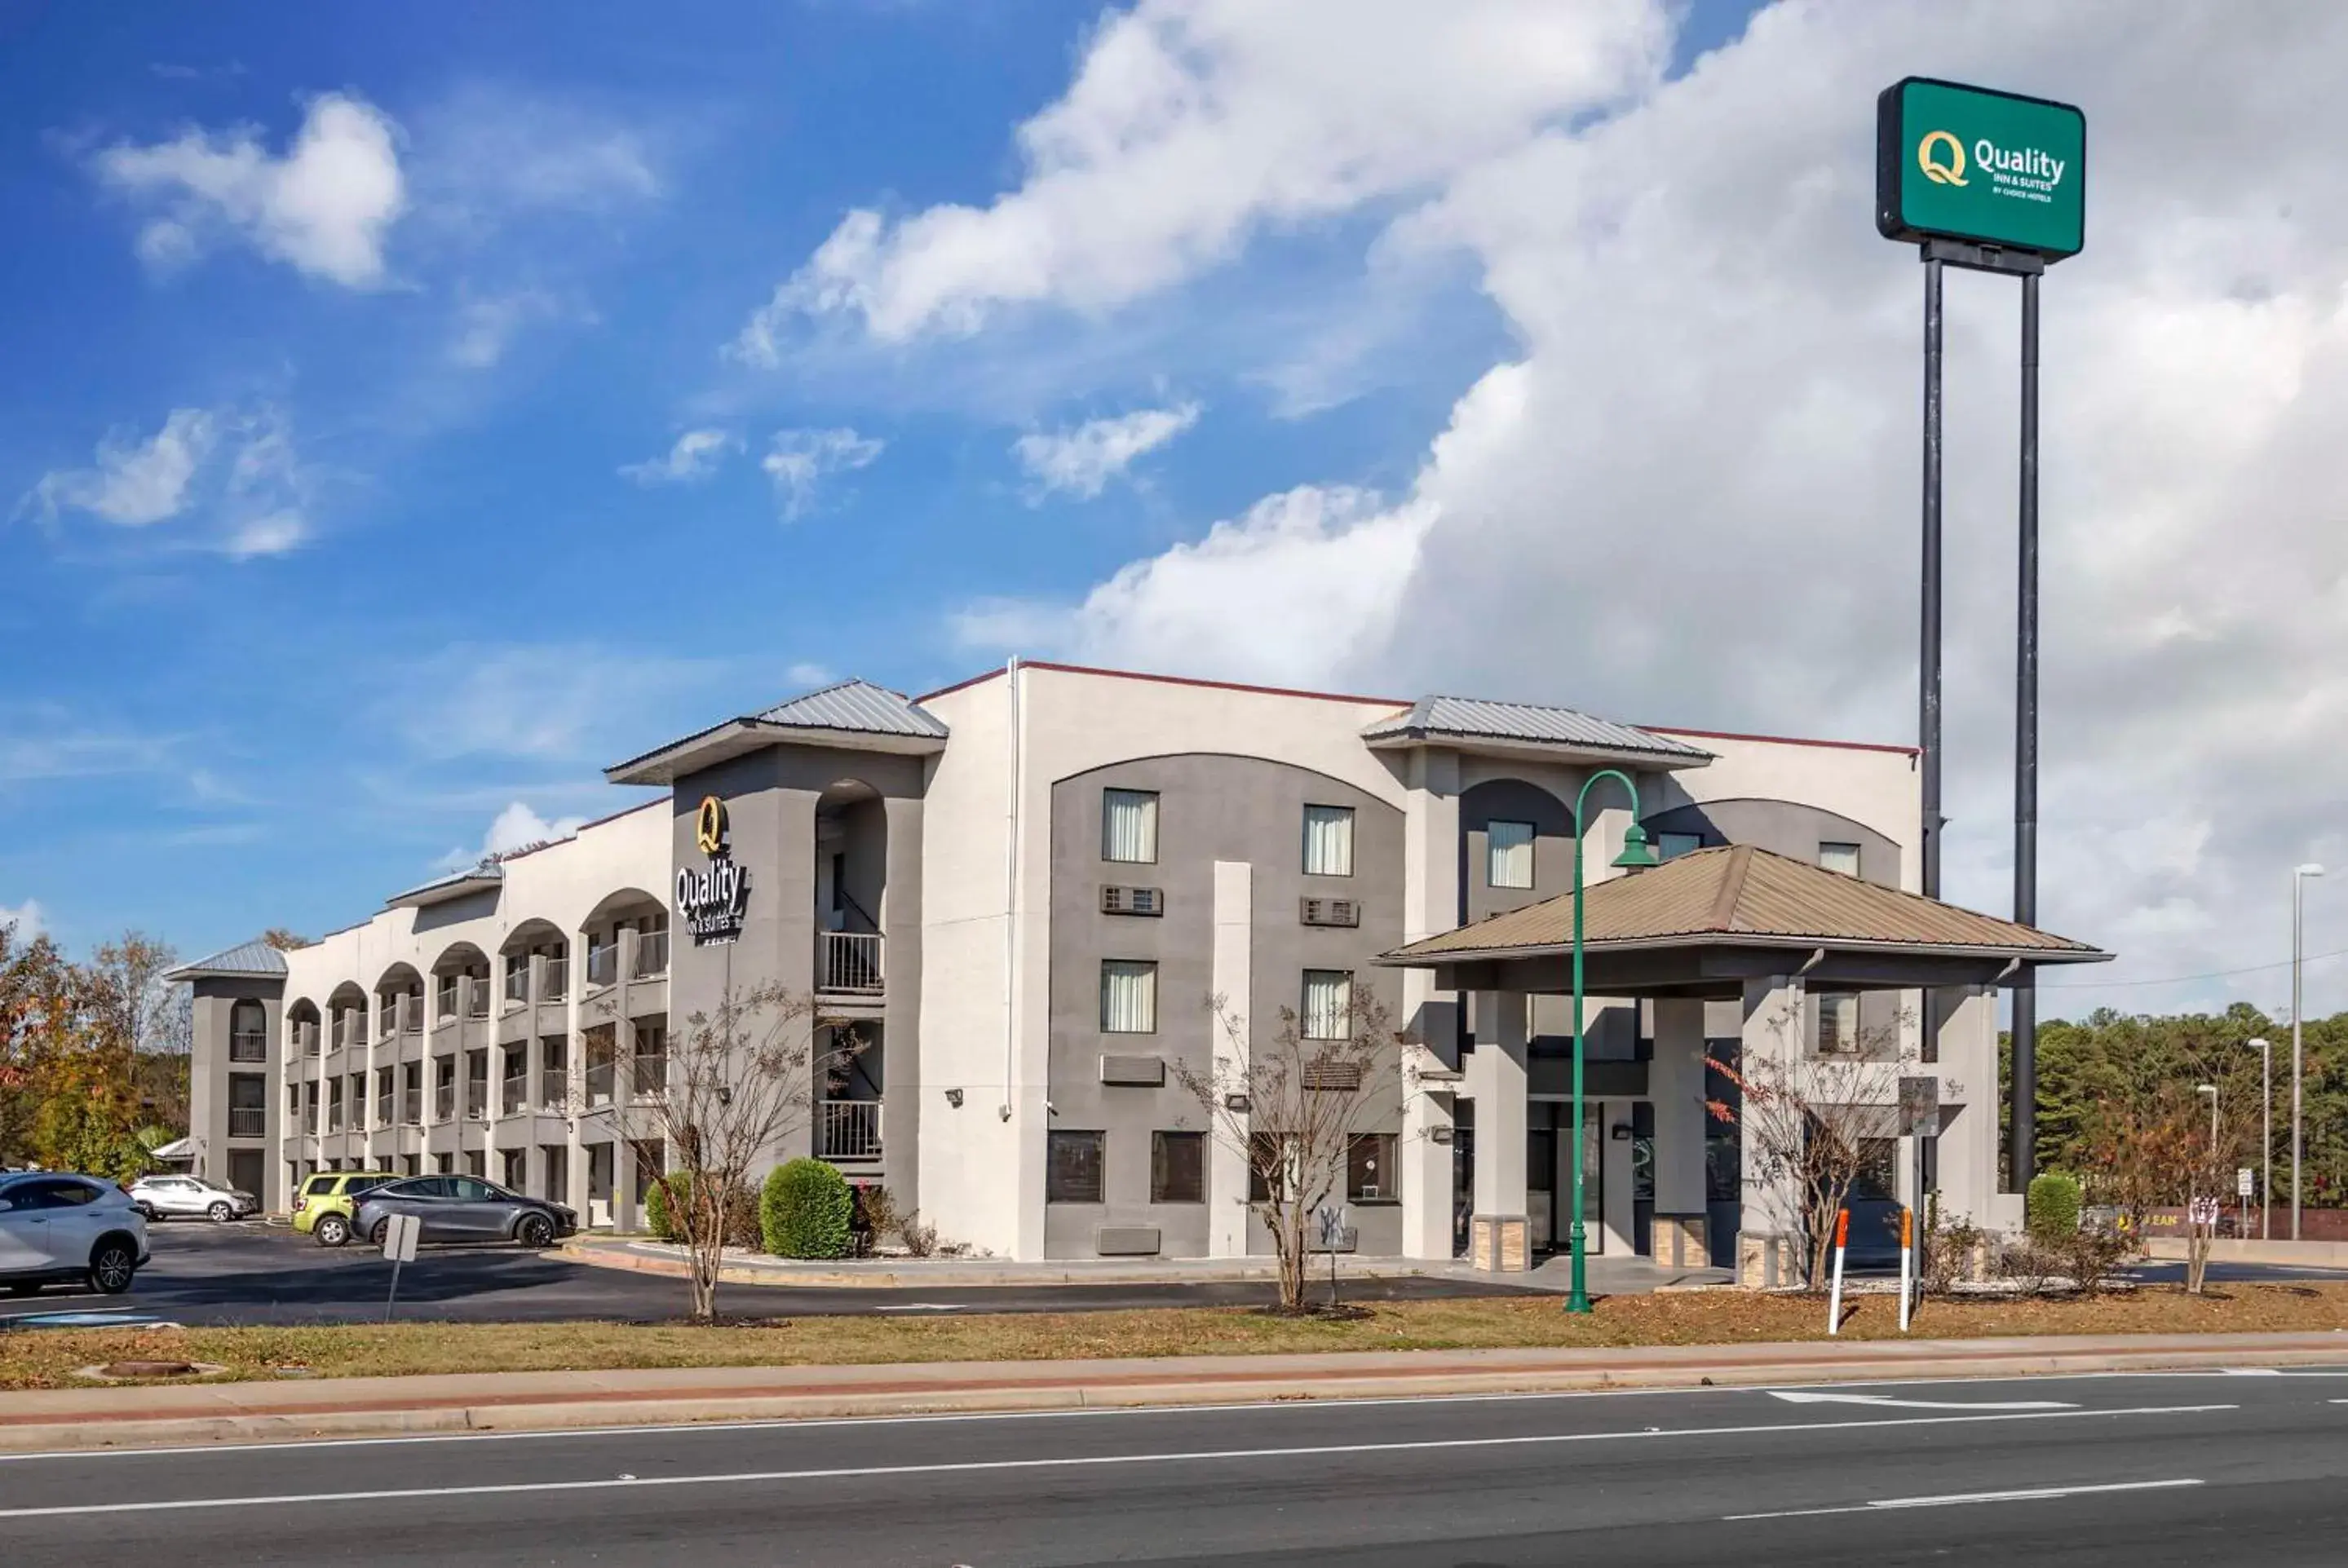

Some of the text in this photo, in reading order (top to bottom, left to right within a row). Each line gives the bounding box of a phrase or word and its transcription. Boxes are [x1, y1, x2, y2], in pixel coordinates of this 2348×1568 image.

[1918, 130, 1969, 187] Q
[1974, 138, 2065, 186] Quality
[1993, 173, 2052, 192] INN & SUITES
[697, 796, 720, 854] Q
[676, 858, 741, 919] Quality
